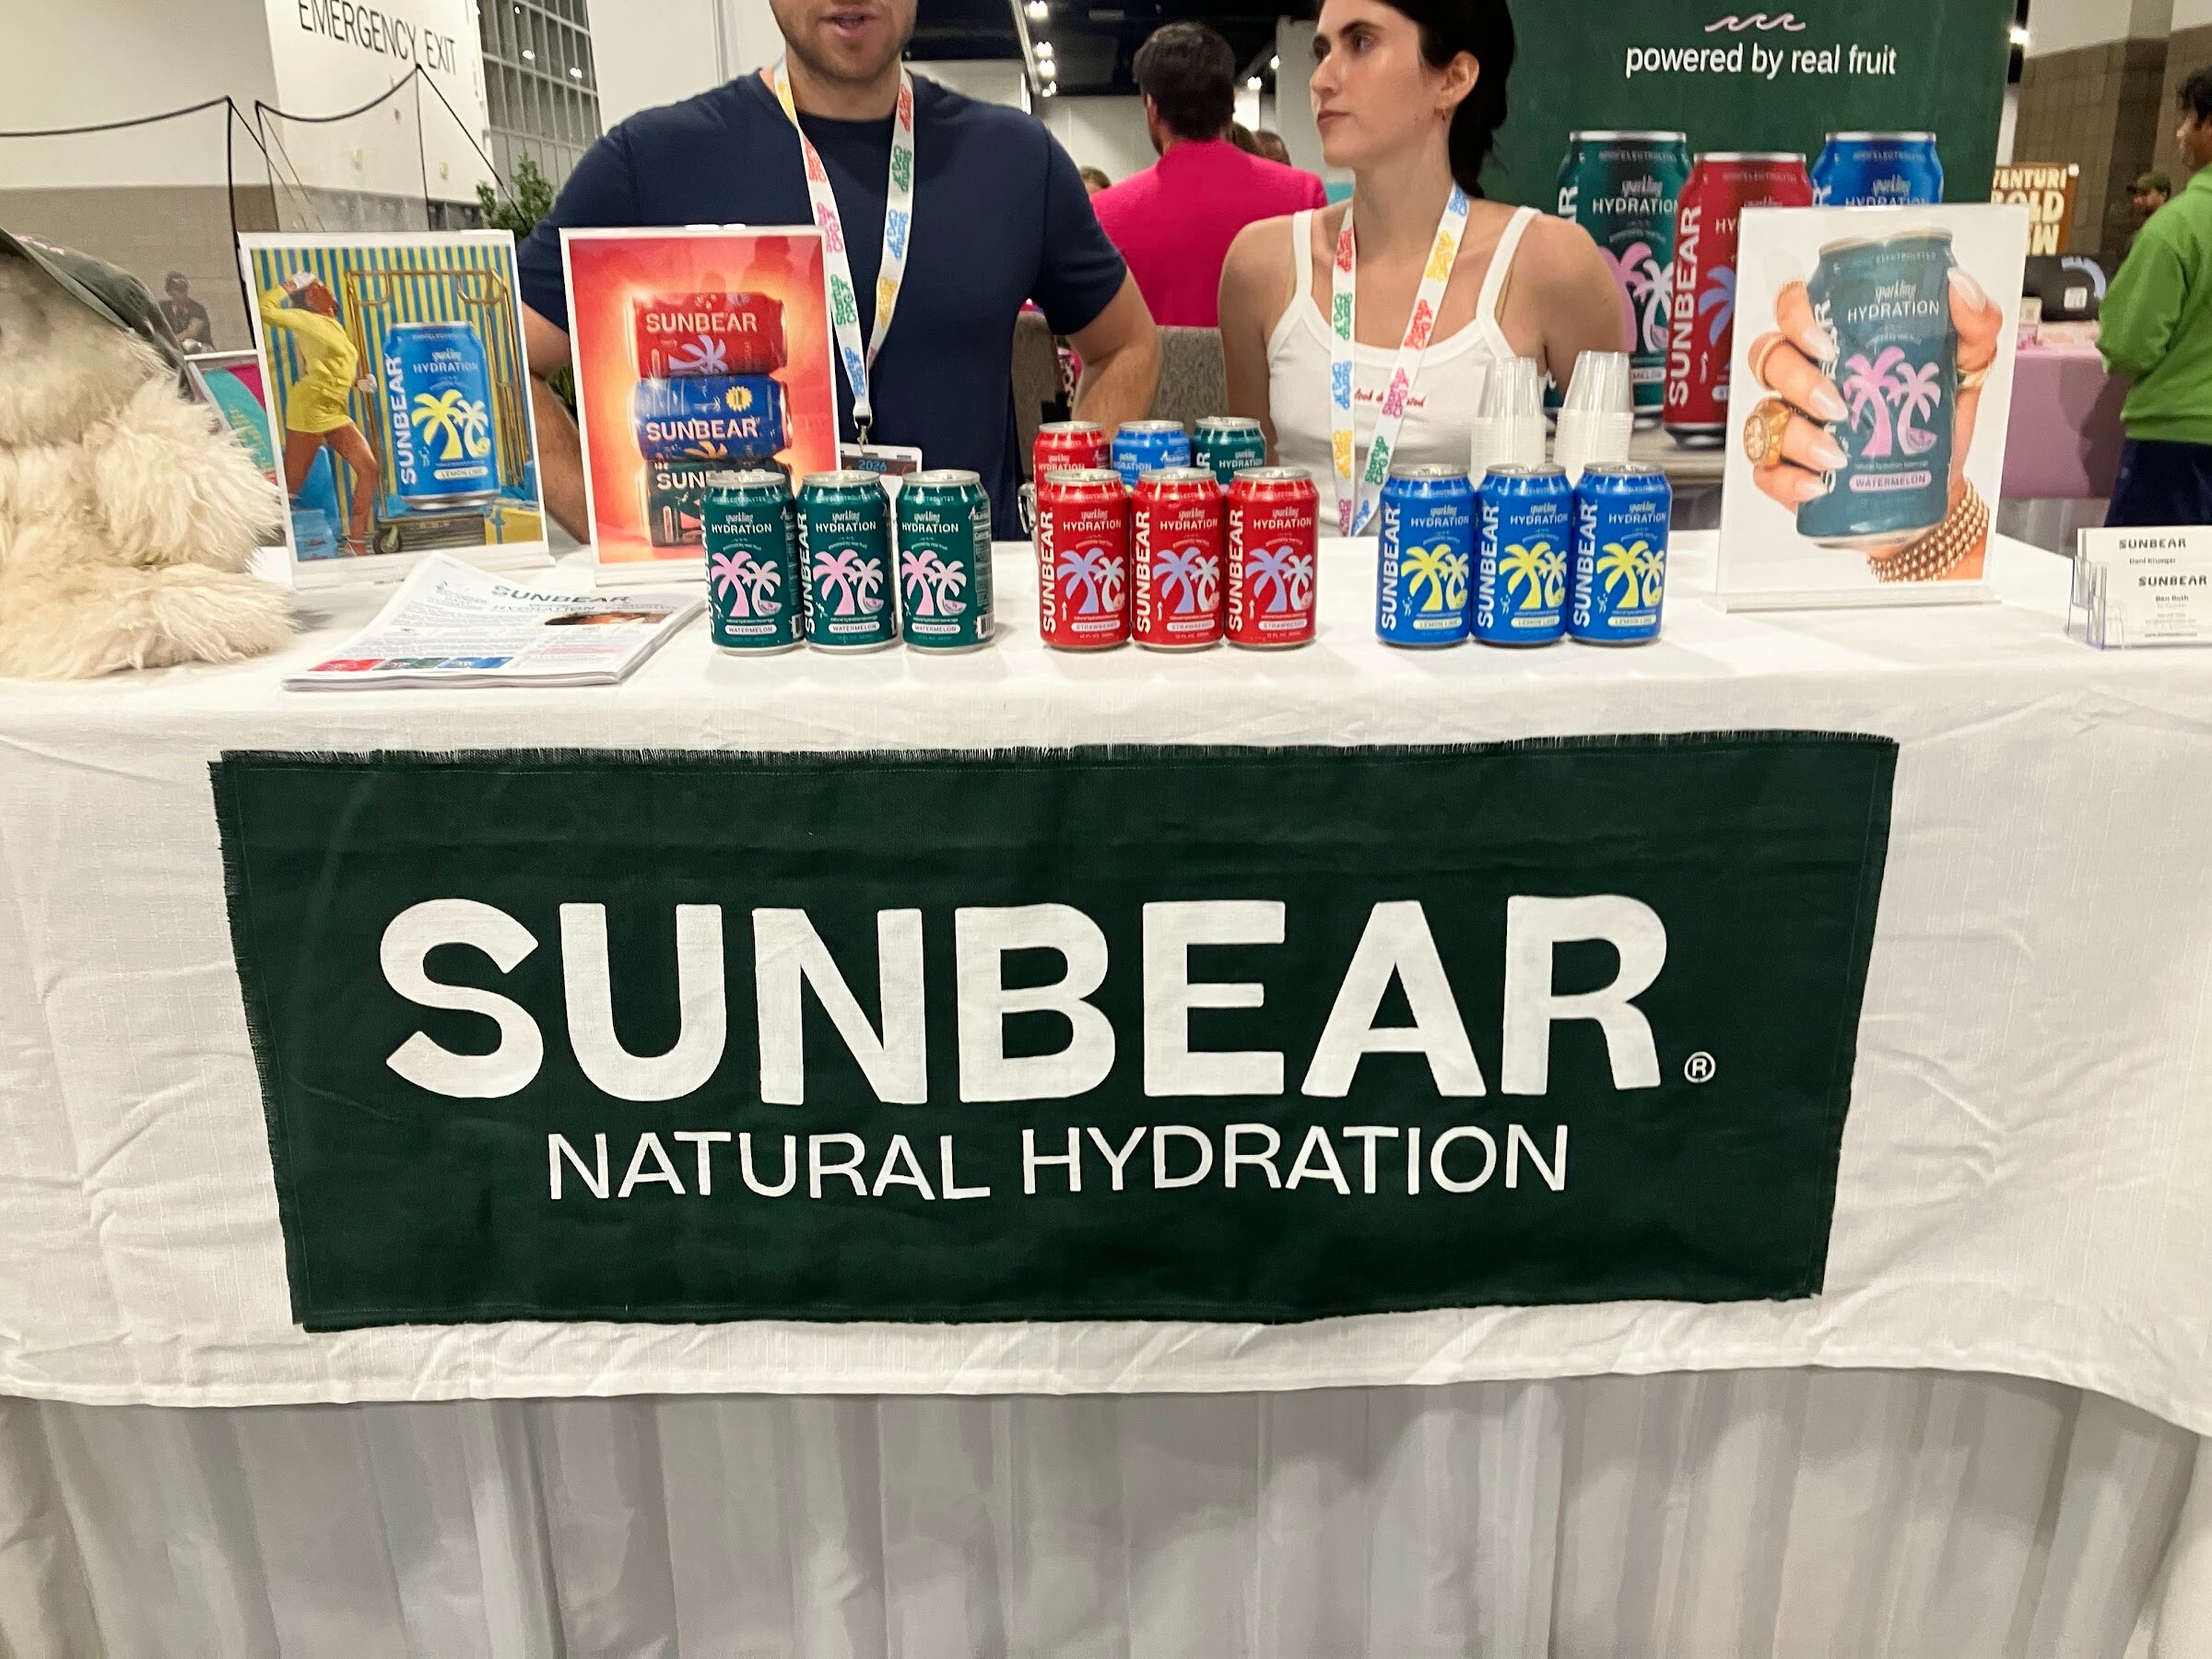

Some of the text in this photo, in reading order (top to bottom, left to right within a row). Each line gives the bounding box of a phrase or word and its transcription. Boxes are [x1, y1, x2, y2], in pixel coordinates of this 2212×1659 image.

[299, 0, 456, 75] EMERGENCY EXIT
[1625, 43, 1897, 79] powered by real fruit
[1668, 206, 1702, 407] SUNBEAR
[1848, 300, 1940, 325] HYDRATION
[645, 312, 758, 334] SUNBEAR
[413, 361, 478, 374] HYDRATION
[385, 354, 417, 485] SUNBEAR
[647, 418, 759, 442] SUNBEAR
[858, 459, 887, 472] 2026
[1855, 474, 1925, 488] WATERMELON
[725, 511, 754, 524] sparkling
[831, 510, 861, 524] sparkling
[913, 510, 941, 524] sparkling
[1253, 517, 1312, 530] HYDRATION
[1410, 515, 1469, 528] HYDRATION
[1510, 512, 1568, 525] HYDRATION
[1608, 512, 1666, 524] HYDRATION
[711, 523, 772, 534] HYDRATION
[816, 522, 877, 533] HYDRATION
[901, 523, 959, 534] HYDRATION
[1063, 520, 1122, 532] HYDRATION
[1159, 518, 1218, 531] HYDRATION
[2119, 537, 2186, 549] SUNBEAR
[1041, 511, 1056, 634] SUNBEAR
[1135, 511, 1151, 634] SUNBEAR
[1229, 509, 1243, 632] SUNBEAR
[1382, 506, 1400, 631] SUNBEAR
[1477, 505, 1500, 629] SUNBEAR
[1573, 503, 1598, 628] SUNBEAR
[796, 512, 816, 635] SUNBEAR
[2138, 575, 2207, 587] SUNBEAR
[491, 584, 630, 604] SUNBEAR
[728, 626, 773, 634] WATERMELON
[381, 895, 1667, 1106] SUNBEAR
[548, 1124, 1568, 1201] NATURAL HYDRATION
